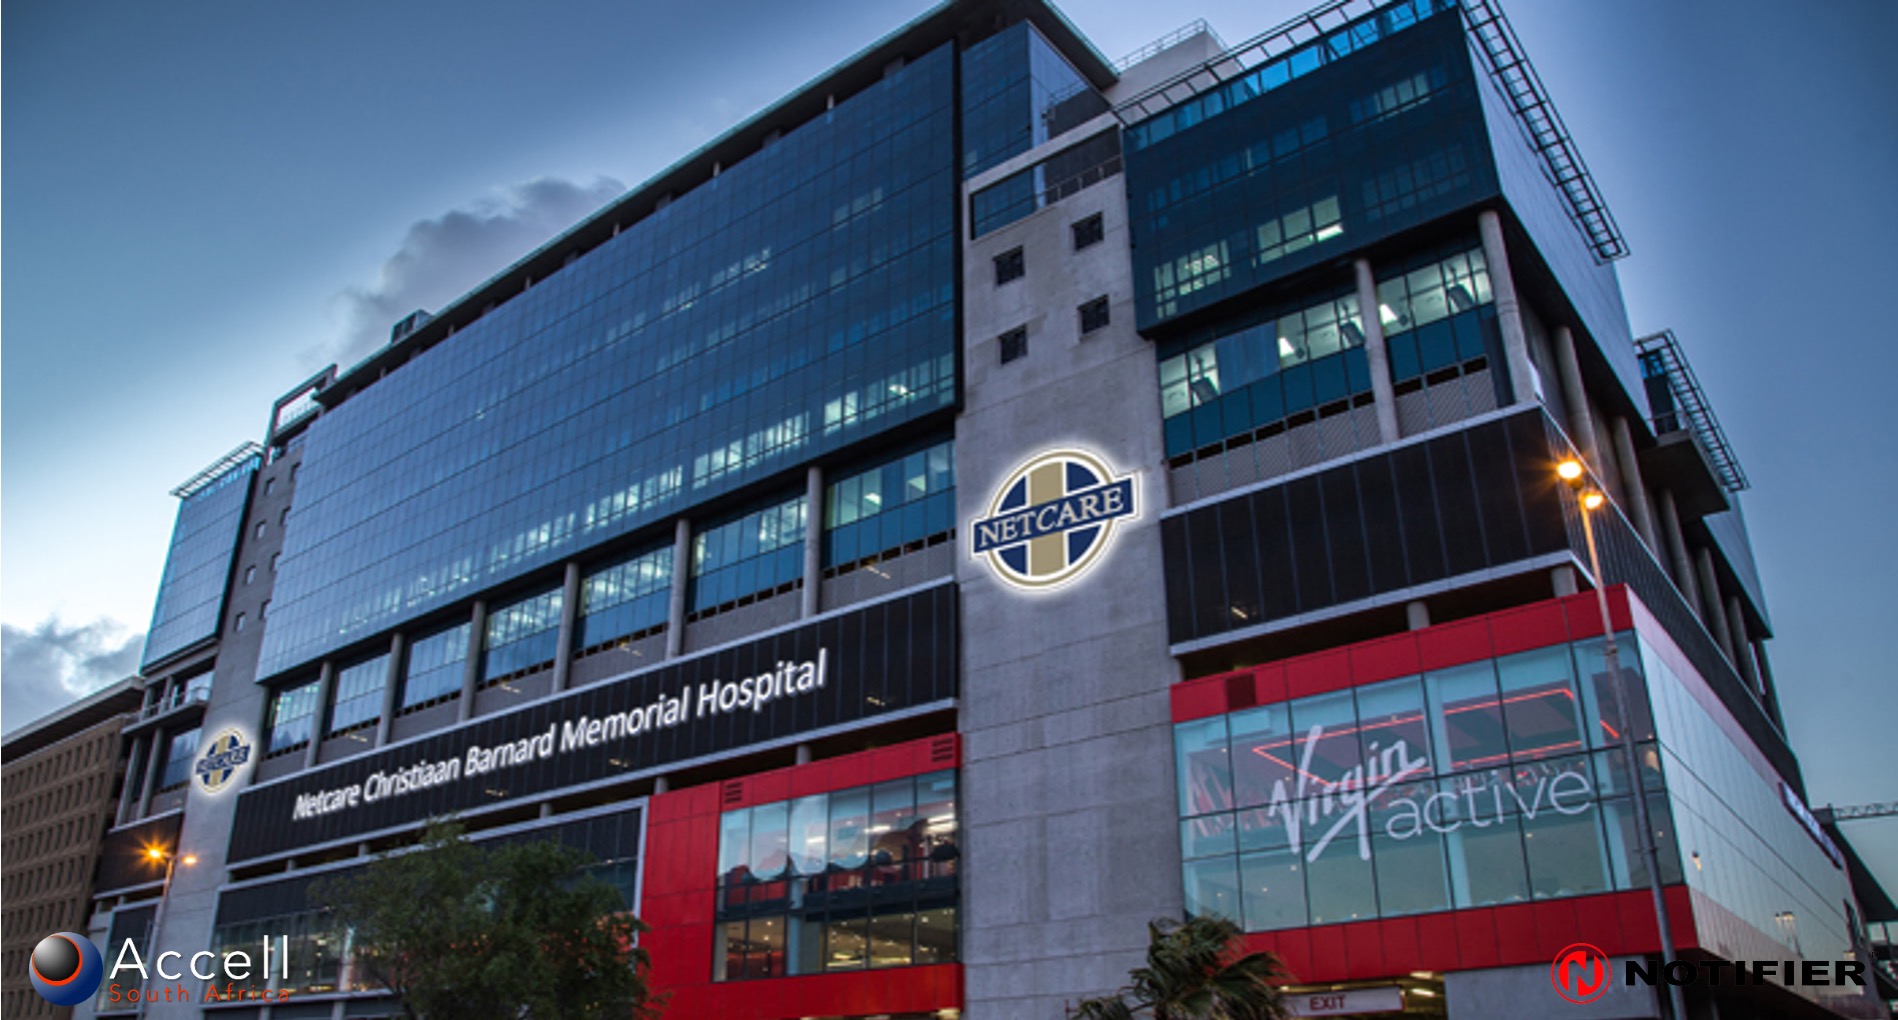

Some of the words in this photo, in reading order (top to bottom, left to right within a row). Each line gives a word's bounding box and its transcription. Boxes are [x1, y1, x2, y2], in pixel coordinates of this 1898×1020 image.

[979, 487, 1124, 548] NETCARE
[293, 783, 361, 821] Netcare
[364, 759, 460, 802] Christiaan
[464, 723, 557, 777] Barnard
[560, 686, 690, 752] Memorial
[697, 648, 827, 717] Hospital
[1268, 725, 1426, 862] Virgin
[1386, 769, 1592, 839] active
[1309, 994, 1347, 1011] EXIT
